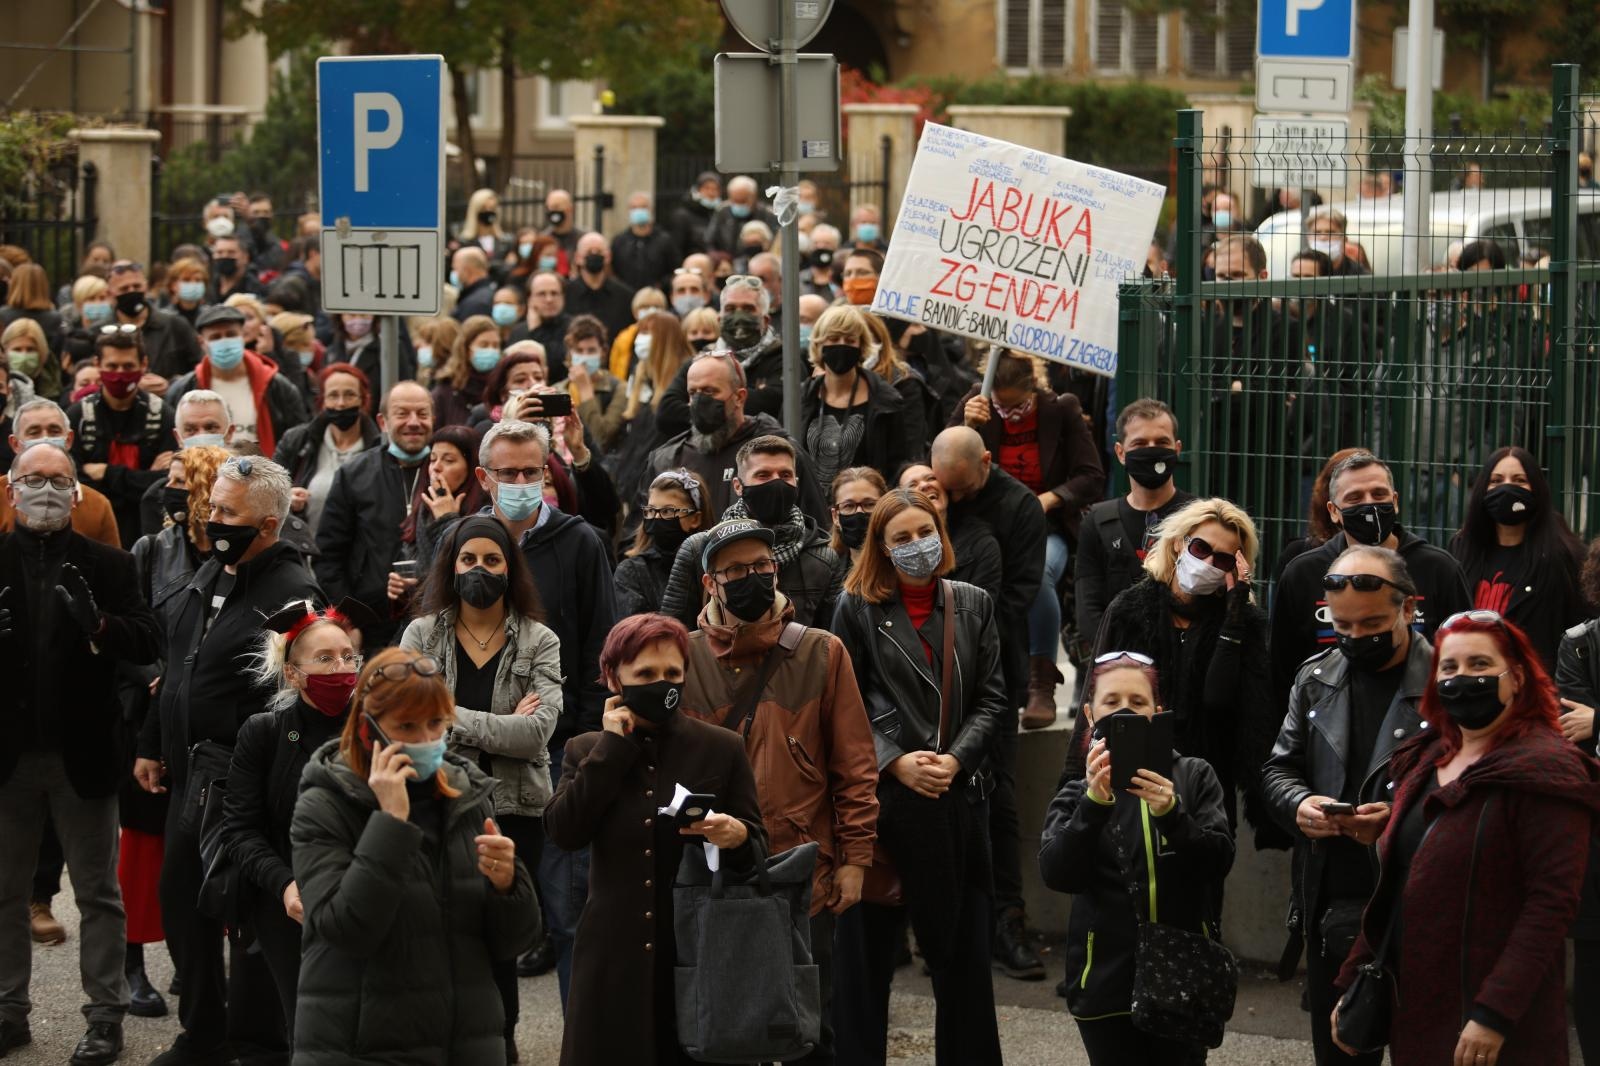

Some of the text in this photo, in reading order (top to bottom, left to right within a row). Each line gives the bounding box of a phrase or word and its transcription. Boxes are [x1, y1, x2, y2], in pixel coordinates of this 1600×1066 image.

[353, 92, 404, 192] P
[950, 177, 1092, 255] JABUKA
[939, 218, 1090, 288] UGROŽENI
[878, 288, 921, 317] DOLJE
[1008, 323, 1066, 358] SLOBODA
[929, 258, 1080, 330] ZG-ENDEM
[716, 522, 753, 539] VANS
